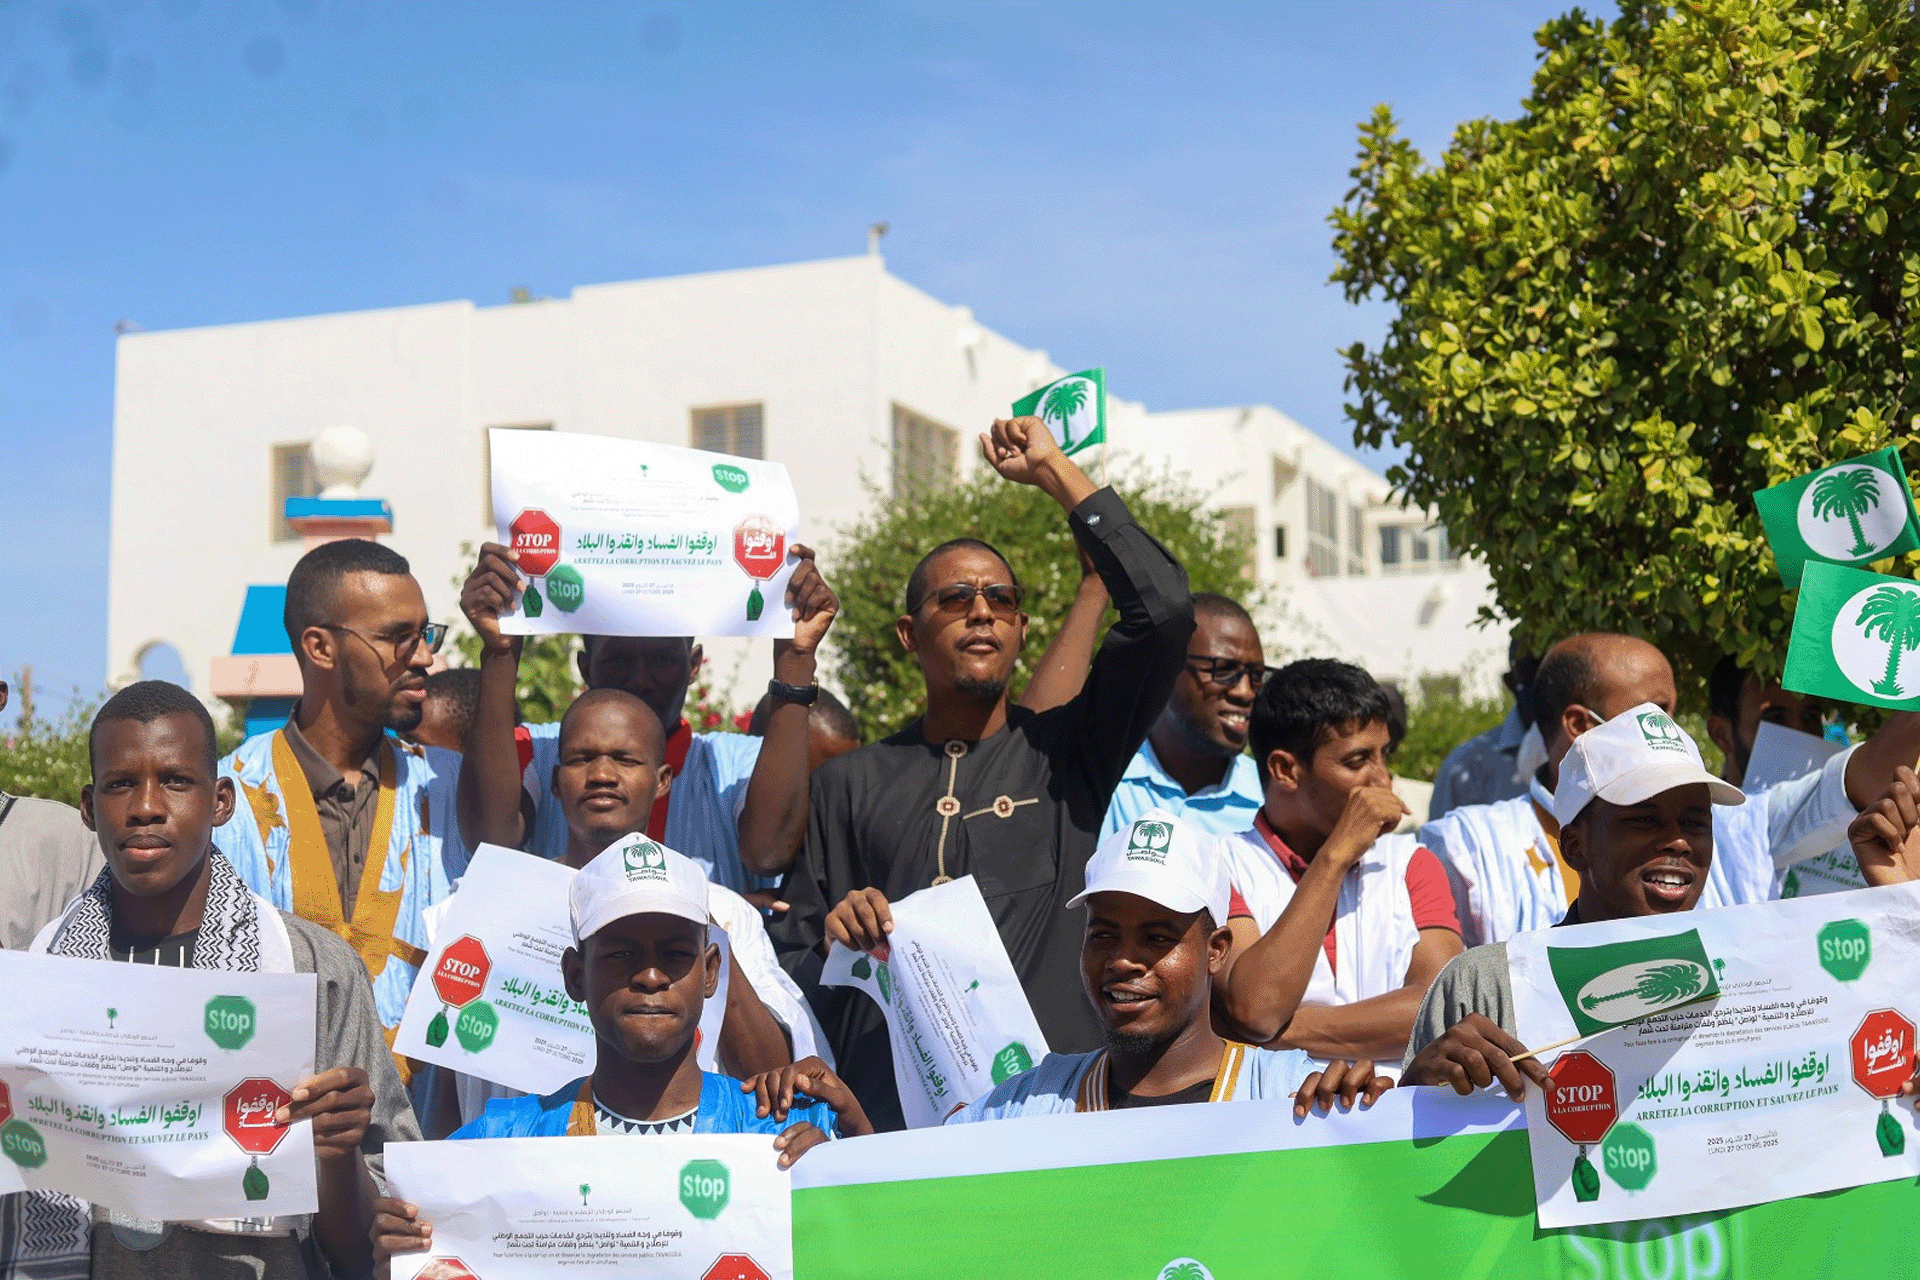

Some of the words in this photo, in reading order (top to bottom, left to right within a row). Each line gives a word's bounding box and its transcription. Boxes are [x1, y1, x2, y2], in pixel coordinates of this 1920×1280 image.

[714, 469, 746, 485] Stop
[516, 533, 552, 547] STOP
[575, 533, 604, 553] البلاد
[646, 533, 684, 550] الفساد
[685, 531, 717, 555] اوقفوا
[549, 579, 580, 601] Stop
[1126, 856, 1166, 866] TAWASSOUL
[628, 875, 669, 883] TAWASSOUL
[1822, 936, 1866, 962] Stop
[443, 957, 481, 979] STOP
[500, 977, 532, 999] البلاد
[209, 1009, 250, 1034] Stop
[494, 998, 526, 1013] ARRETEZ
[525, 1008, 534, 1017] LA
[535, 1011, 580, 1030] CORRUPTION
[580, 1025, 589, 1033] ET
[459, 1014, 492, 1041] Stop
[911, 1032, 934, 1066] الفساد
[1864, 1028, 1904, 1067] اوقفوا
[1734, 1060, 1783, 1089] الفساد
[1787, 1051, 1830, 1088] اوقفوا
[1556, 1084, 1603, 1105] STOP
[1637, 1073, 1673, 1103] البلاد
[1677, 1068, 1730, 1102] وانقذوا
[28, 1095, 58, 1116] البلاد
[236, 1093, 280, 1119] اوقفوا
[1567, 1103, 1612, 1113] CORRUPTION
[1636, 1108, 1679, 1121] ARRETEZ
[1680, 1107, 1693, 1116] LA
[1694, 1099, 1756, 1115] CORRUPTION
[1756, 1097, 1768, 1107] ET
[1770, 1092, 1804, 1106] SAUVEZ
[1805, 1089, 1817, 1099] LE
[1817, 1084, 1839, 1097] PAYS
[61, 1100, 105, 1129] وانقذوا
[109, 1104, 157, 1126] الفساد
[160, 1100, 202, 1129] اوقفوا
[4, 1133, 42, 1156] Stop
[64, 1125, 74, 1133] LA
[75, 1127, 127, 1144] CORRUPTION
[128, 1136, 139, 1144] ET
[141, 1133, 174, 1144] SAUVEZ
[176, 1133, 186, 1141] LE
[186, 1132, 209, 1142] PAYS
[1707, 1137, 1724, 1146] 2025
[1727, 1145, 1734, 1153] 27
[1735, 1141, 1762, 1152] OCTOBRE
[1762, 1138, 1779, 1148] 2025
[1743, 1133, 1752, 1141] 27
[1607, 1145, 1651, 1172] Stop
[683, 1173, 725, 1202] Stop
[1566, 1219, 1723, 1280] Stop
